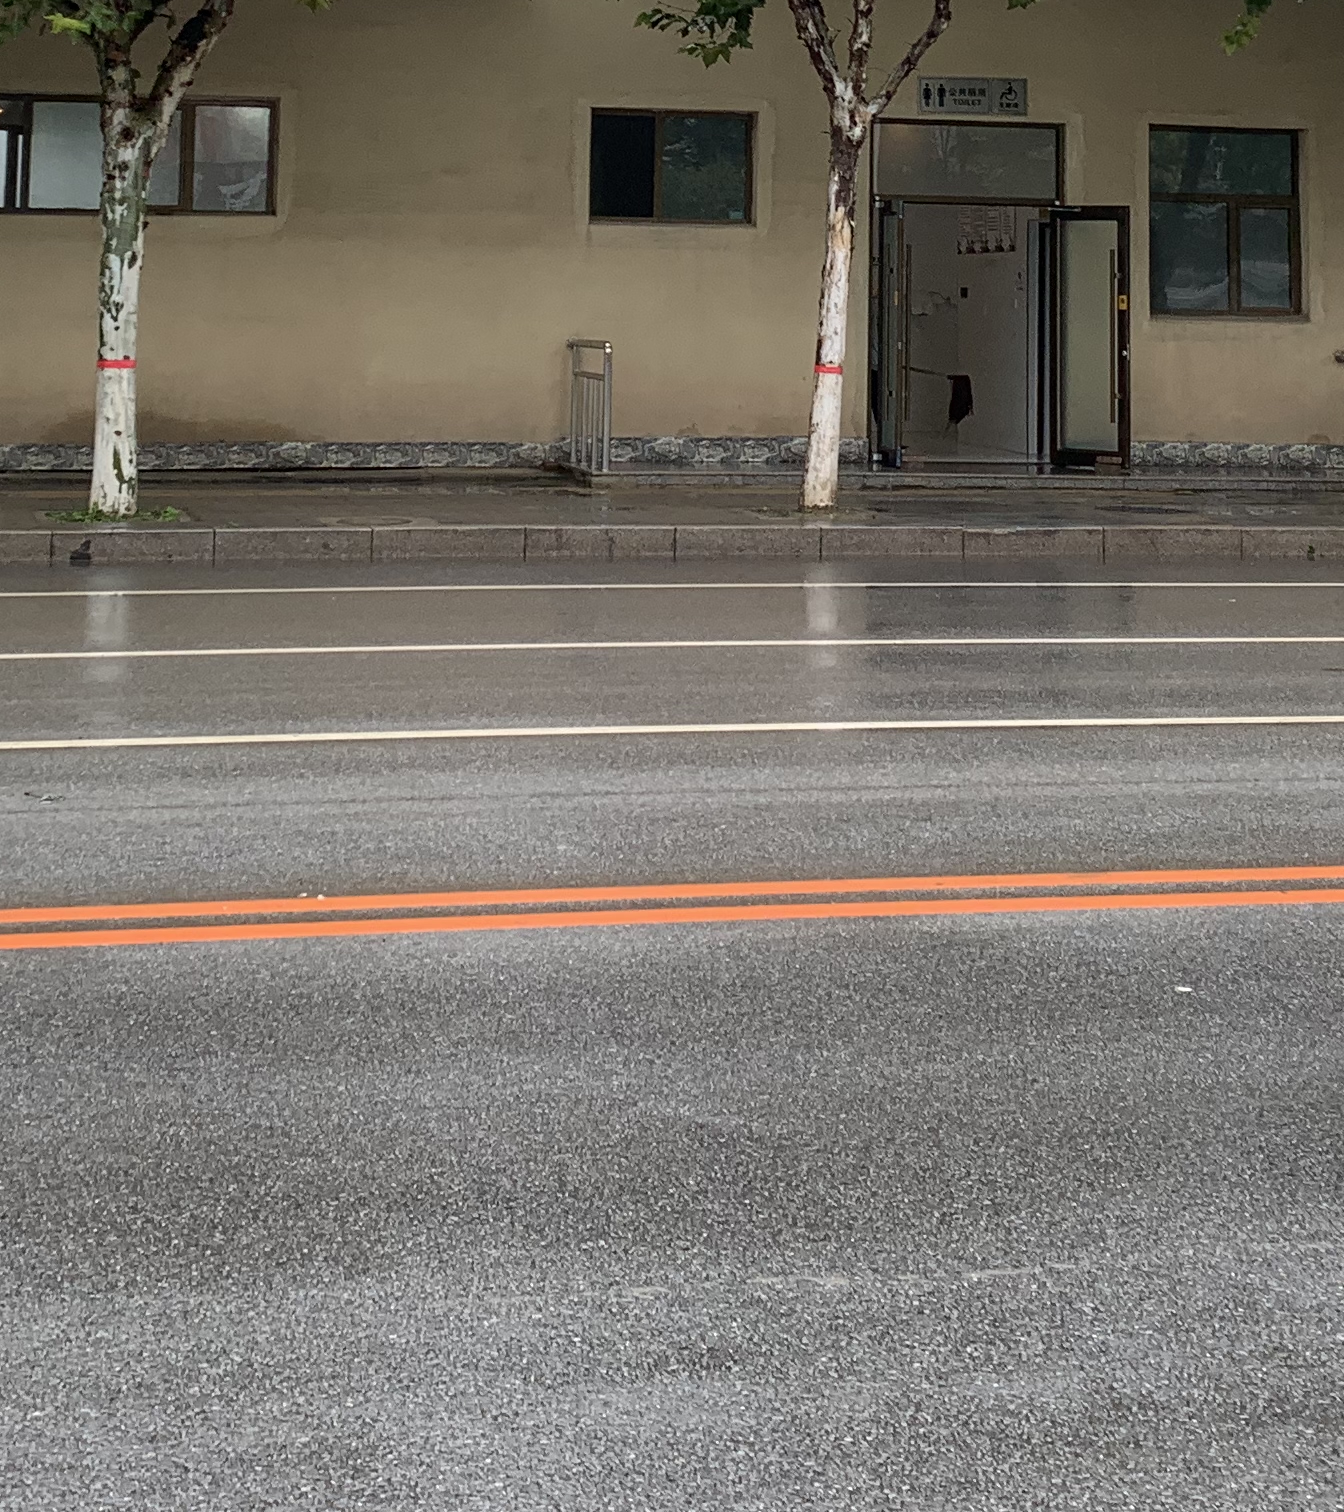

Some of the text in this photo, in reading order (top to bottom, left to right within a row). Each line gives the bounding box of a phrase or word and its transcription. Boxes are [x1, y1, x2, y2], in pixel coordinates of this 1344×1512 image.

[949, 87, 986, 98] 公共厕所
[953, 98, 982, 107] TOILET
